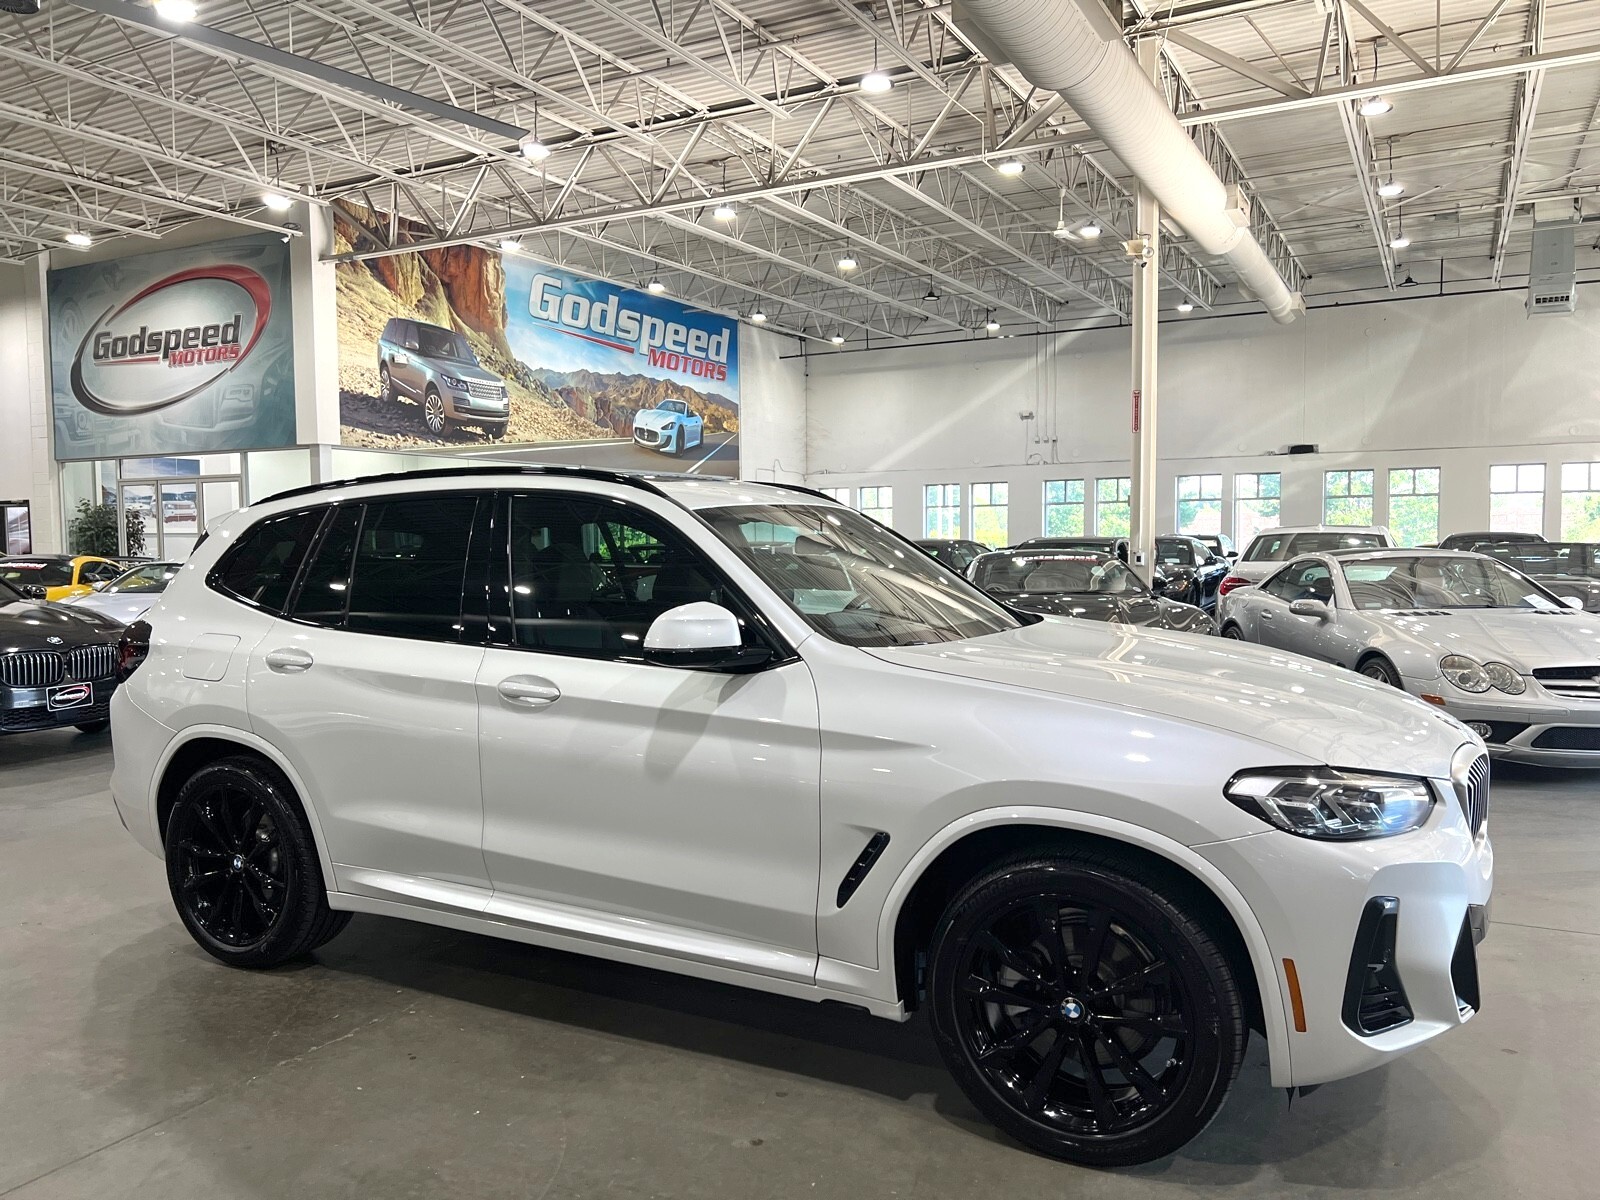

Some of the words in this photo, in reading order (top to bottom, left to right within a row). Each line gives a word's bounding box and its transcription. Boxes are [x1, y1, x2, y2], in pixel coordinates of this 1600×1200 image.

[93, 313, 242, 360] Godspeed
[529, 273, 730, 364] Godspeed
[168, 344, 241, 368] MOTORS
[648, 347, 728, 381] MOTORS
